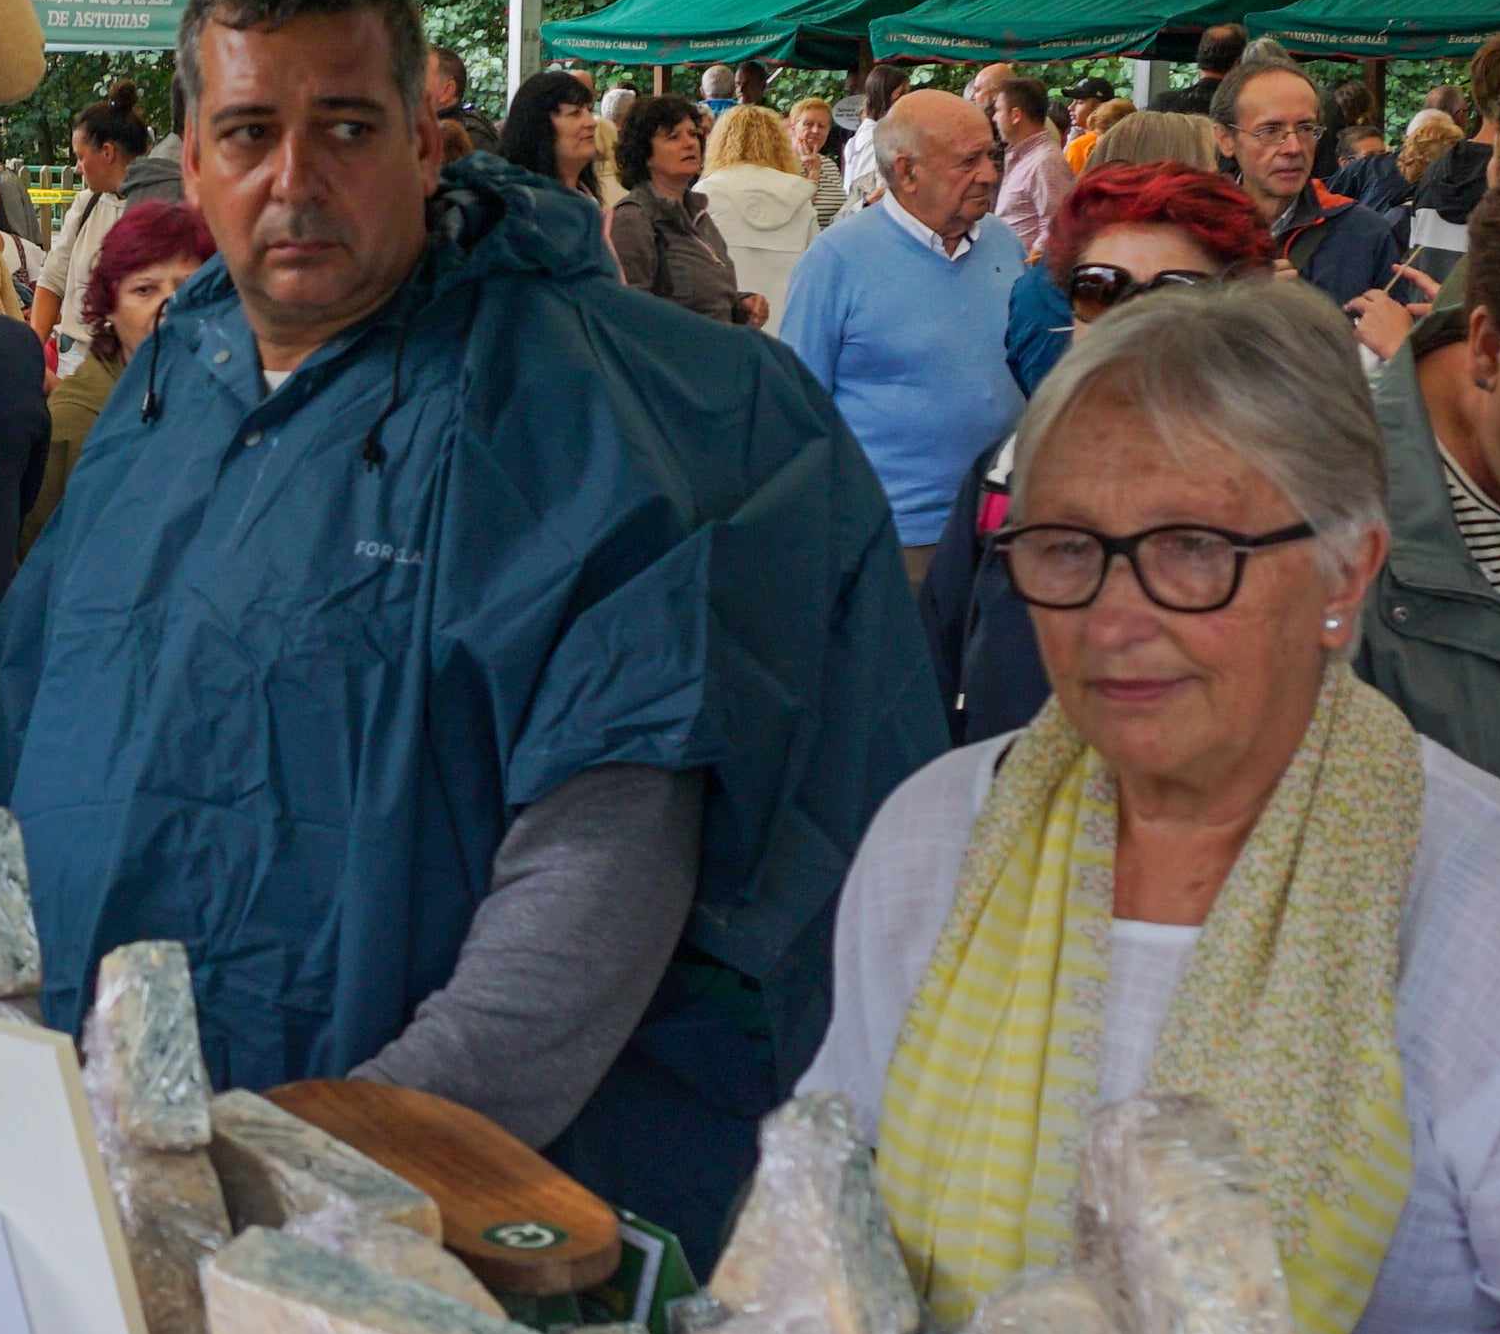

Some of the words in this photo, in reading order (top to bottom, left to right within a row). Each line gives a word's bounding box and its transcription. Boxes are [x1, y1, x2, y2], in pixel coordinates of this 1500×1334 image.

[47, 10, 69, 27] DE
[72, 11, 150, 29] ASTURIAS
[1339, 34, 1388, 45] CABRALES
[612, 40, 648, 51] CABRALES
